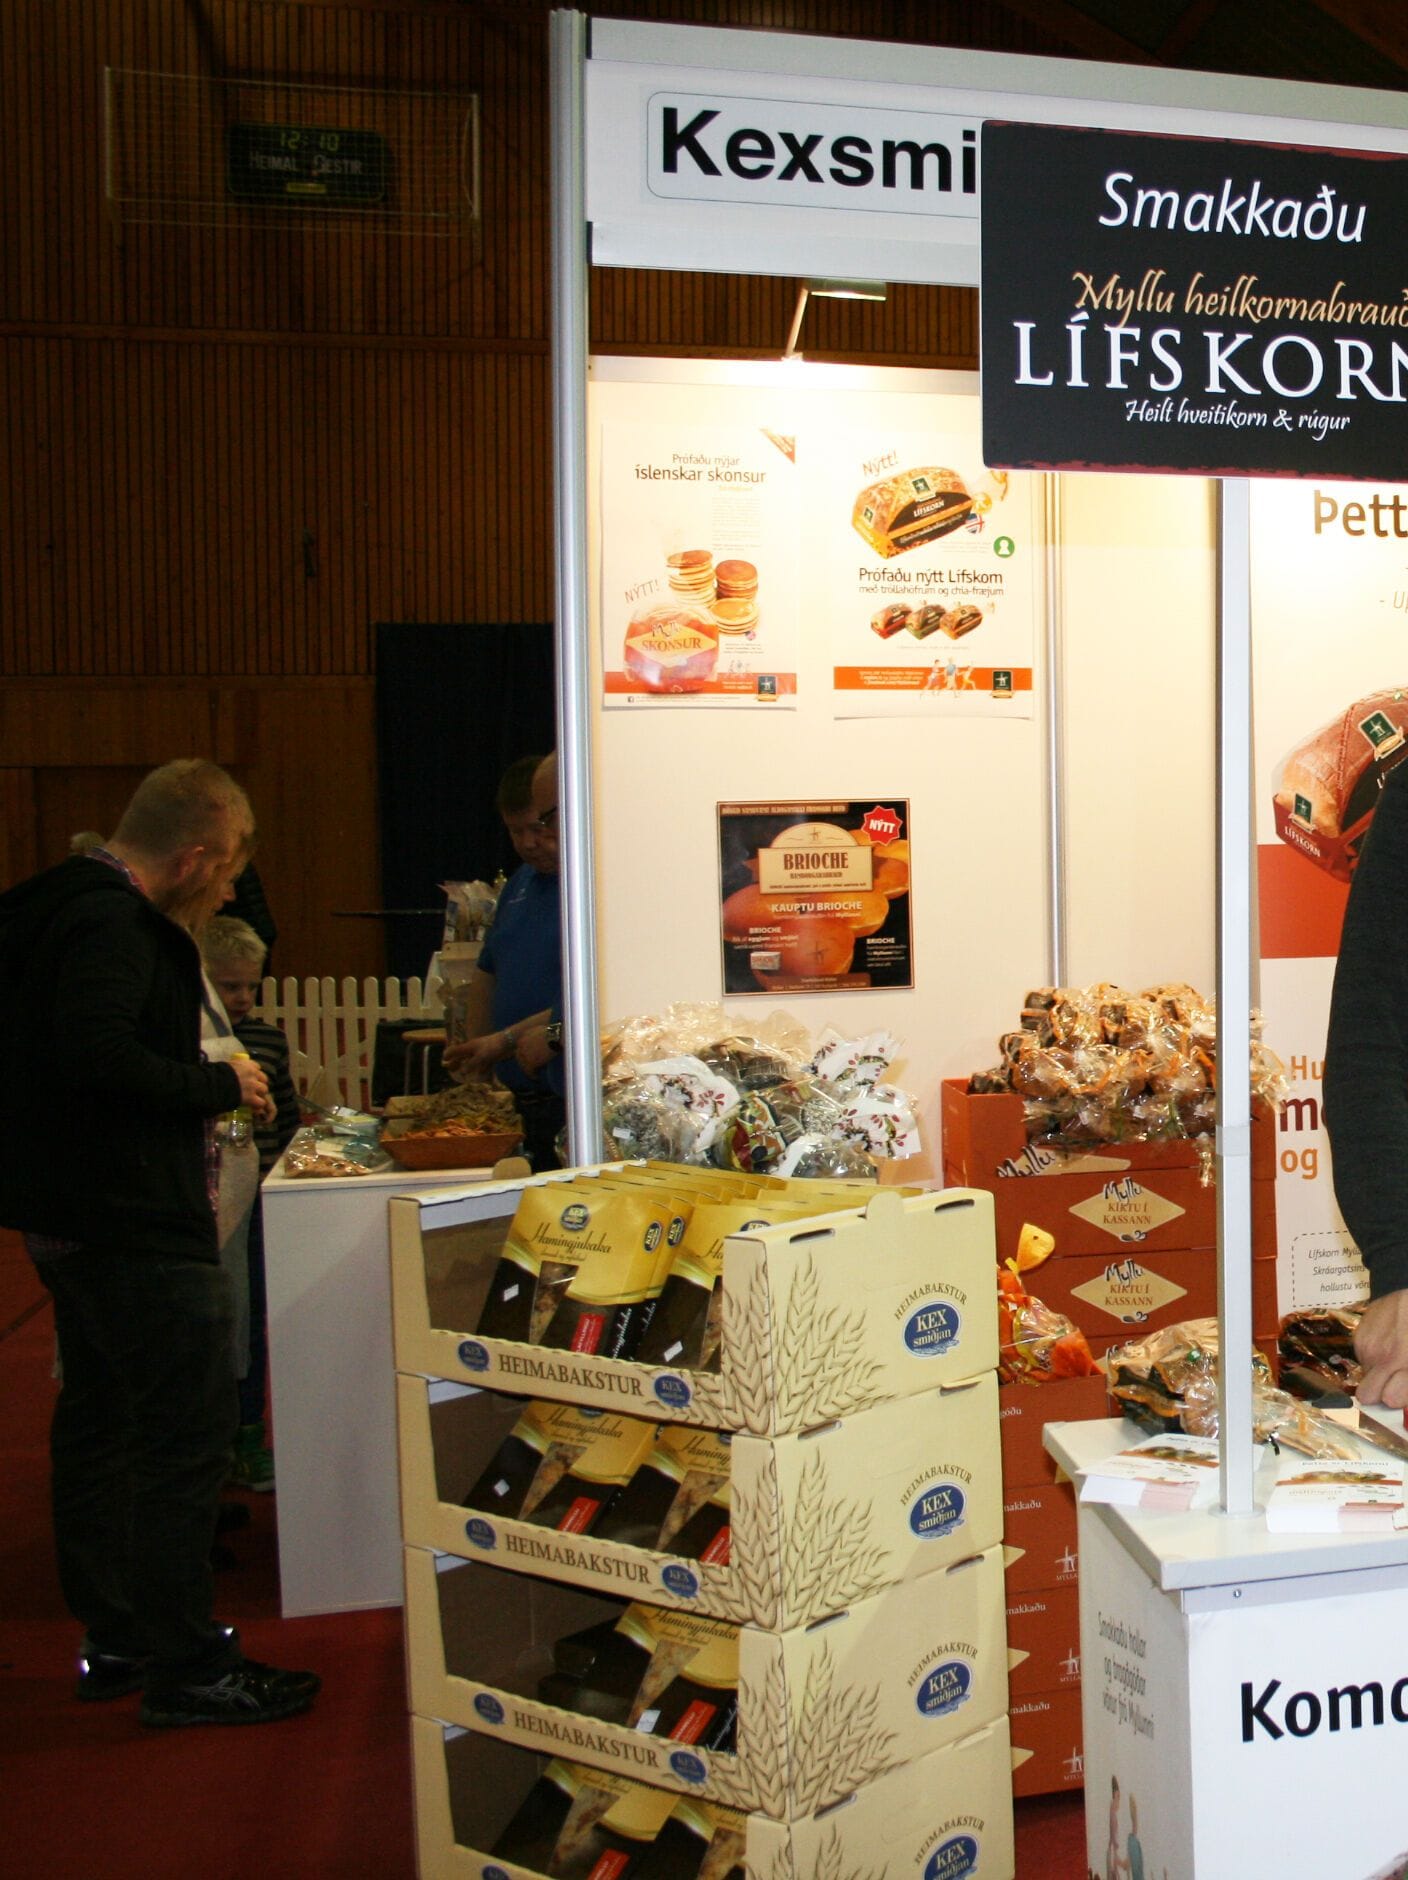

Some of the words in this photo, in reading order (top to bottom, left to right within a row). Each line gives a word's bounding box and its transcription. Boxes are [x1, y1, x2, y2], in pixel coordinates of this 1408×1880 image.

[661, 106, 977, 195] Kexsmi
[1099, 172, 1367, 243] Smakkaðu
[1072, 269, 1174, 330] Myllu
[1125, 399, 1173, 424] Heilt
[1177, 400, 1268, 428] hveitikorn
[1267, 408, 1293, 432] &
[1298, 410, 1351, 441] rúgur
[635, 464, 704, 481] íslenskar
[707, 466, 766, 484] skonsur
[859, 567, 911, 583] Prófaðu
[916, 569, 945, 587] nýtt
[641, 637, 702, 654] SKONSUR
[868, 817, 896, 835] NÝTT
[783, 852, 849, 870] BRIOCHE
[771, 902, 815, 913] KAUPTU
[816, 901, 863, 912] BRIOCHE
[1280, 1148, 1318, 1180] og
[1103, 1214, 1152, 1225] KASSANN
[894, 1282, 968, 1321] HEIMABAKSTUR
[1105, 1297, 1153, 1306] KASSANN
[916, 1308, 948, 1333] KEX
[912, 1328, 952, 1347] smiðjan
[498, 1353, 644, 1397] HEIMABAKSTUR
[900, 1464, 972, 1507] HEIMABAKSTUR
[921, 1489, 953, 1514] KEX
[918, 1509, 957, 1533] smiðjan
[505, 1534, 652, 1585] HEIMABAKSTUR
[1056, 1573, 1078, 1582] MYLLA
[1006, 1603, 1046, 1616] makkaðu
[907, 1641, 979, 1688] HEIMABAKSTUR
[928, 1668, 960, 1694] KEX
[925, 1685, 963, 1710] smiðjan
[1010, 1702, 1050, 1715] makkaðu
[513, 1710, 660, 1769] HEIMABAKSTUR
[914, 1815, 985, 1865] HEIMABAKSTUR
[935, 1841, 967, 1867] KEX
